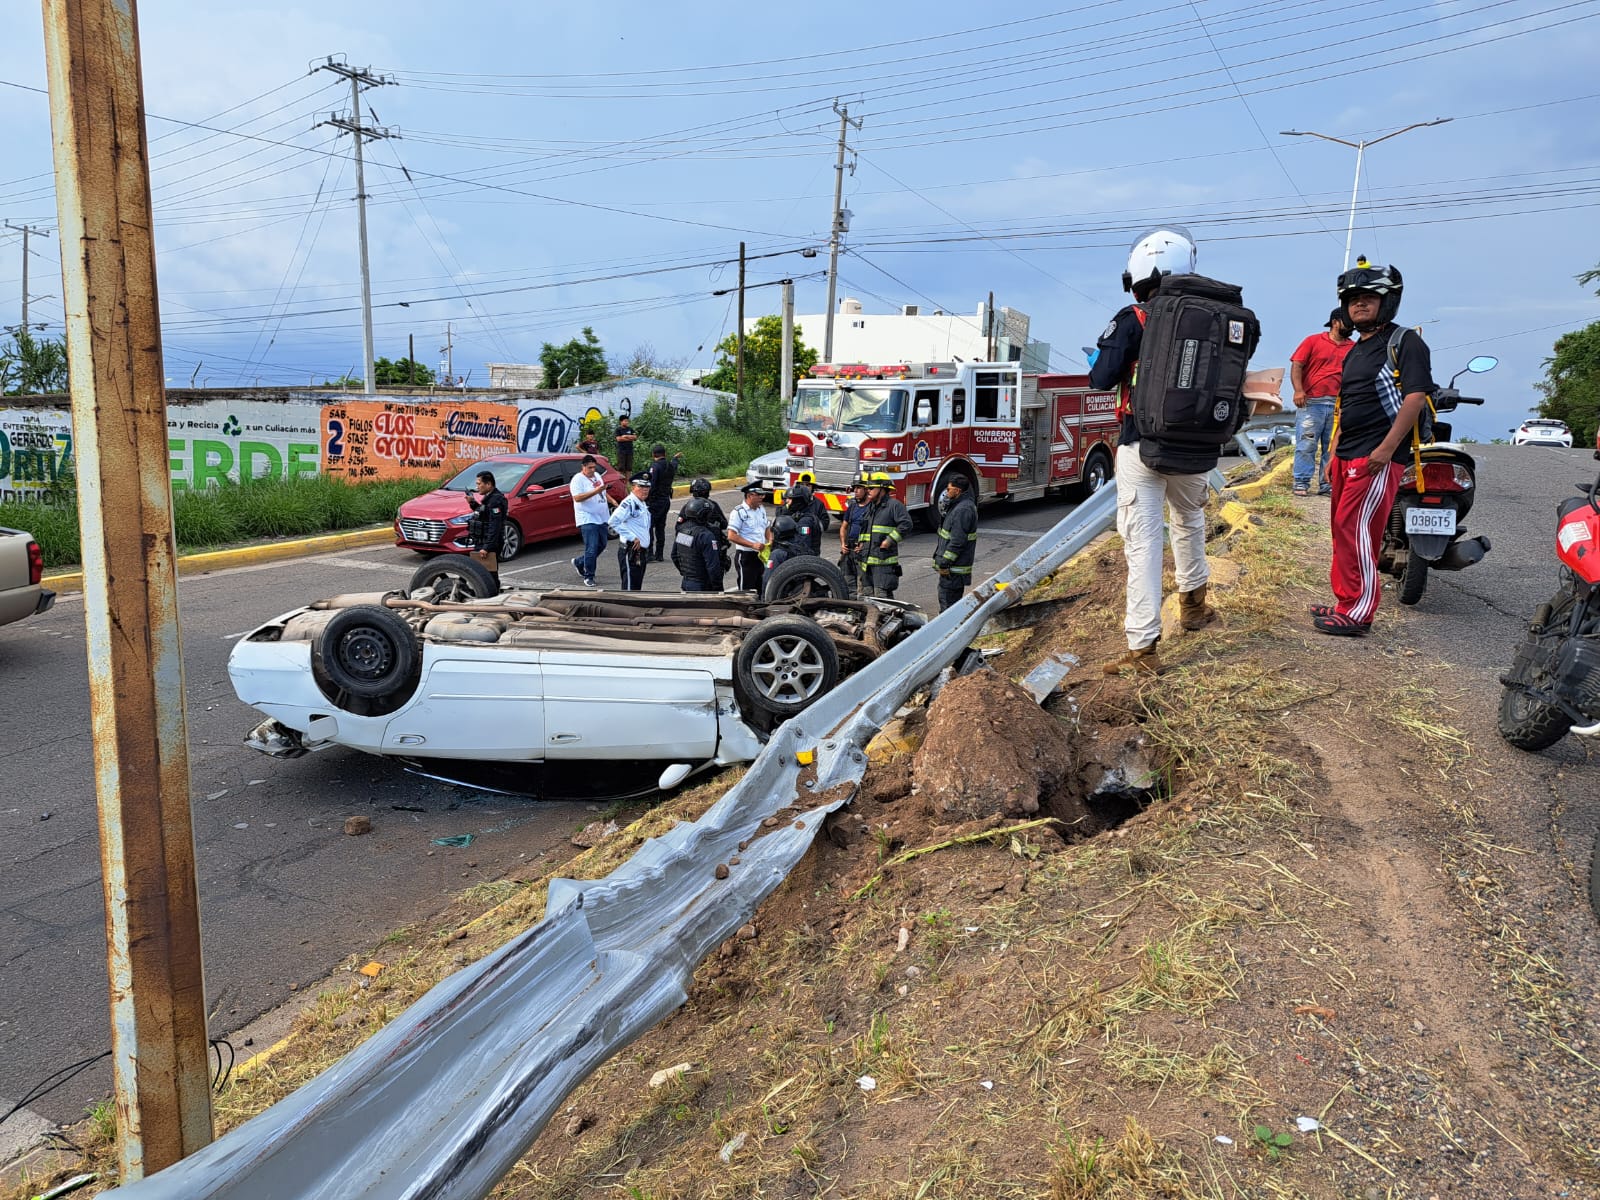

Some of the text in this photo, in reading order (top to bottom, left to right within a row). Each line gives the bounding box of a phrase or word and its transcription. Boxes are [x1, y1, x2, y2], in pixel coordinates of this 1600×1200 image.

[1086, 394, 1117, 404] BOMBERO
[22, 416, 40, 424] TAPIA
[179, 421, 185, 430] y
[187, 420, 219, 430] Recicla
[264, 423, 298, 433] Culiacán
[300, 426, 316, 434] más
[375, 413, 414, 436] LOS
[447, 411, 508, 440] Caminantes
[10, 431, 54, 448] GERARDO
[328, 419, 344, 455] 2
[521, 415, 566, 453] PIO
[974, 430, 1017, 438] BOMBEROS
[976, 436, 1014, 444] CULIACAN
[375, 432, 446, 461] YONIC'S
[892, 443, 904, 457] 47
[167, 439, 318, 490] ERDE
[1411, 515, 1451, 528] 03BGT5
